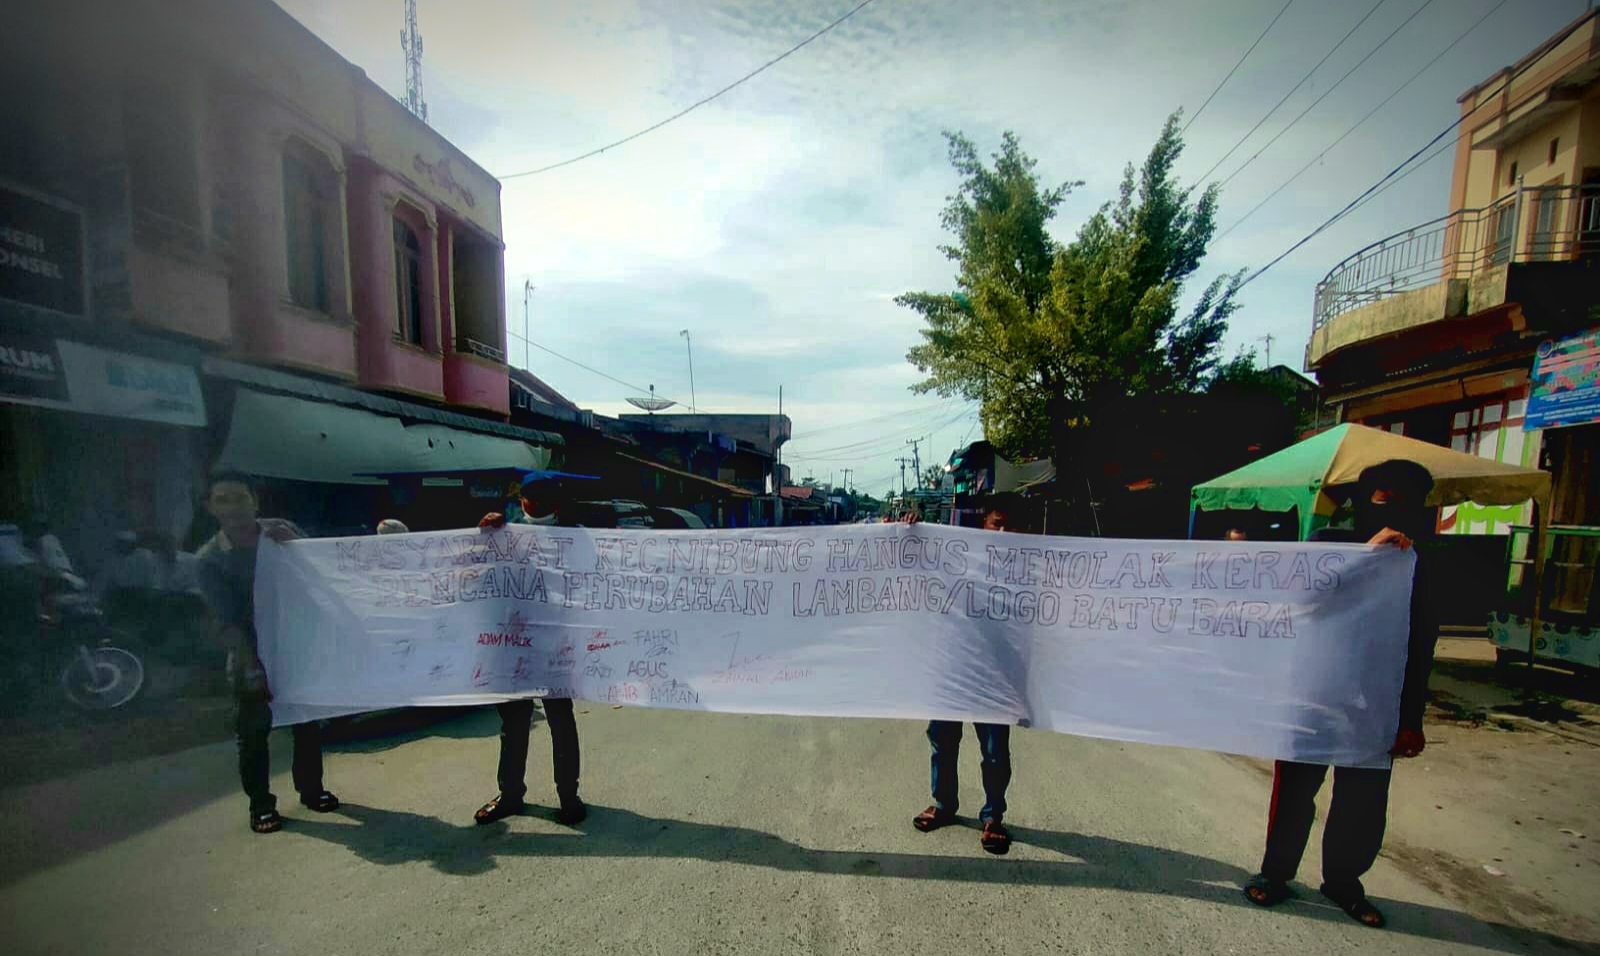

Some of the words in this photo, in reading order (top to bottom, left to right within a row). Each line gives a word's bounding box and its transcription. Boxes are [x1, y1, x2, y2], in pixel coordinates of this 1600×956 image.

[826, 535, 969, 576] HANGUS
[985, 545, 1177, 590] MENOLAK
[1191, 551, 1346, 592] KERAS
[562, 571, 774, 616] PERUBAHAN
[1069, 594, 1182, 634] BATU
[1188, 598, 1297, 639] BARA
[627, 660, 669, 679] AGUS
